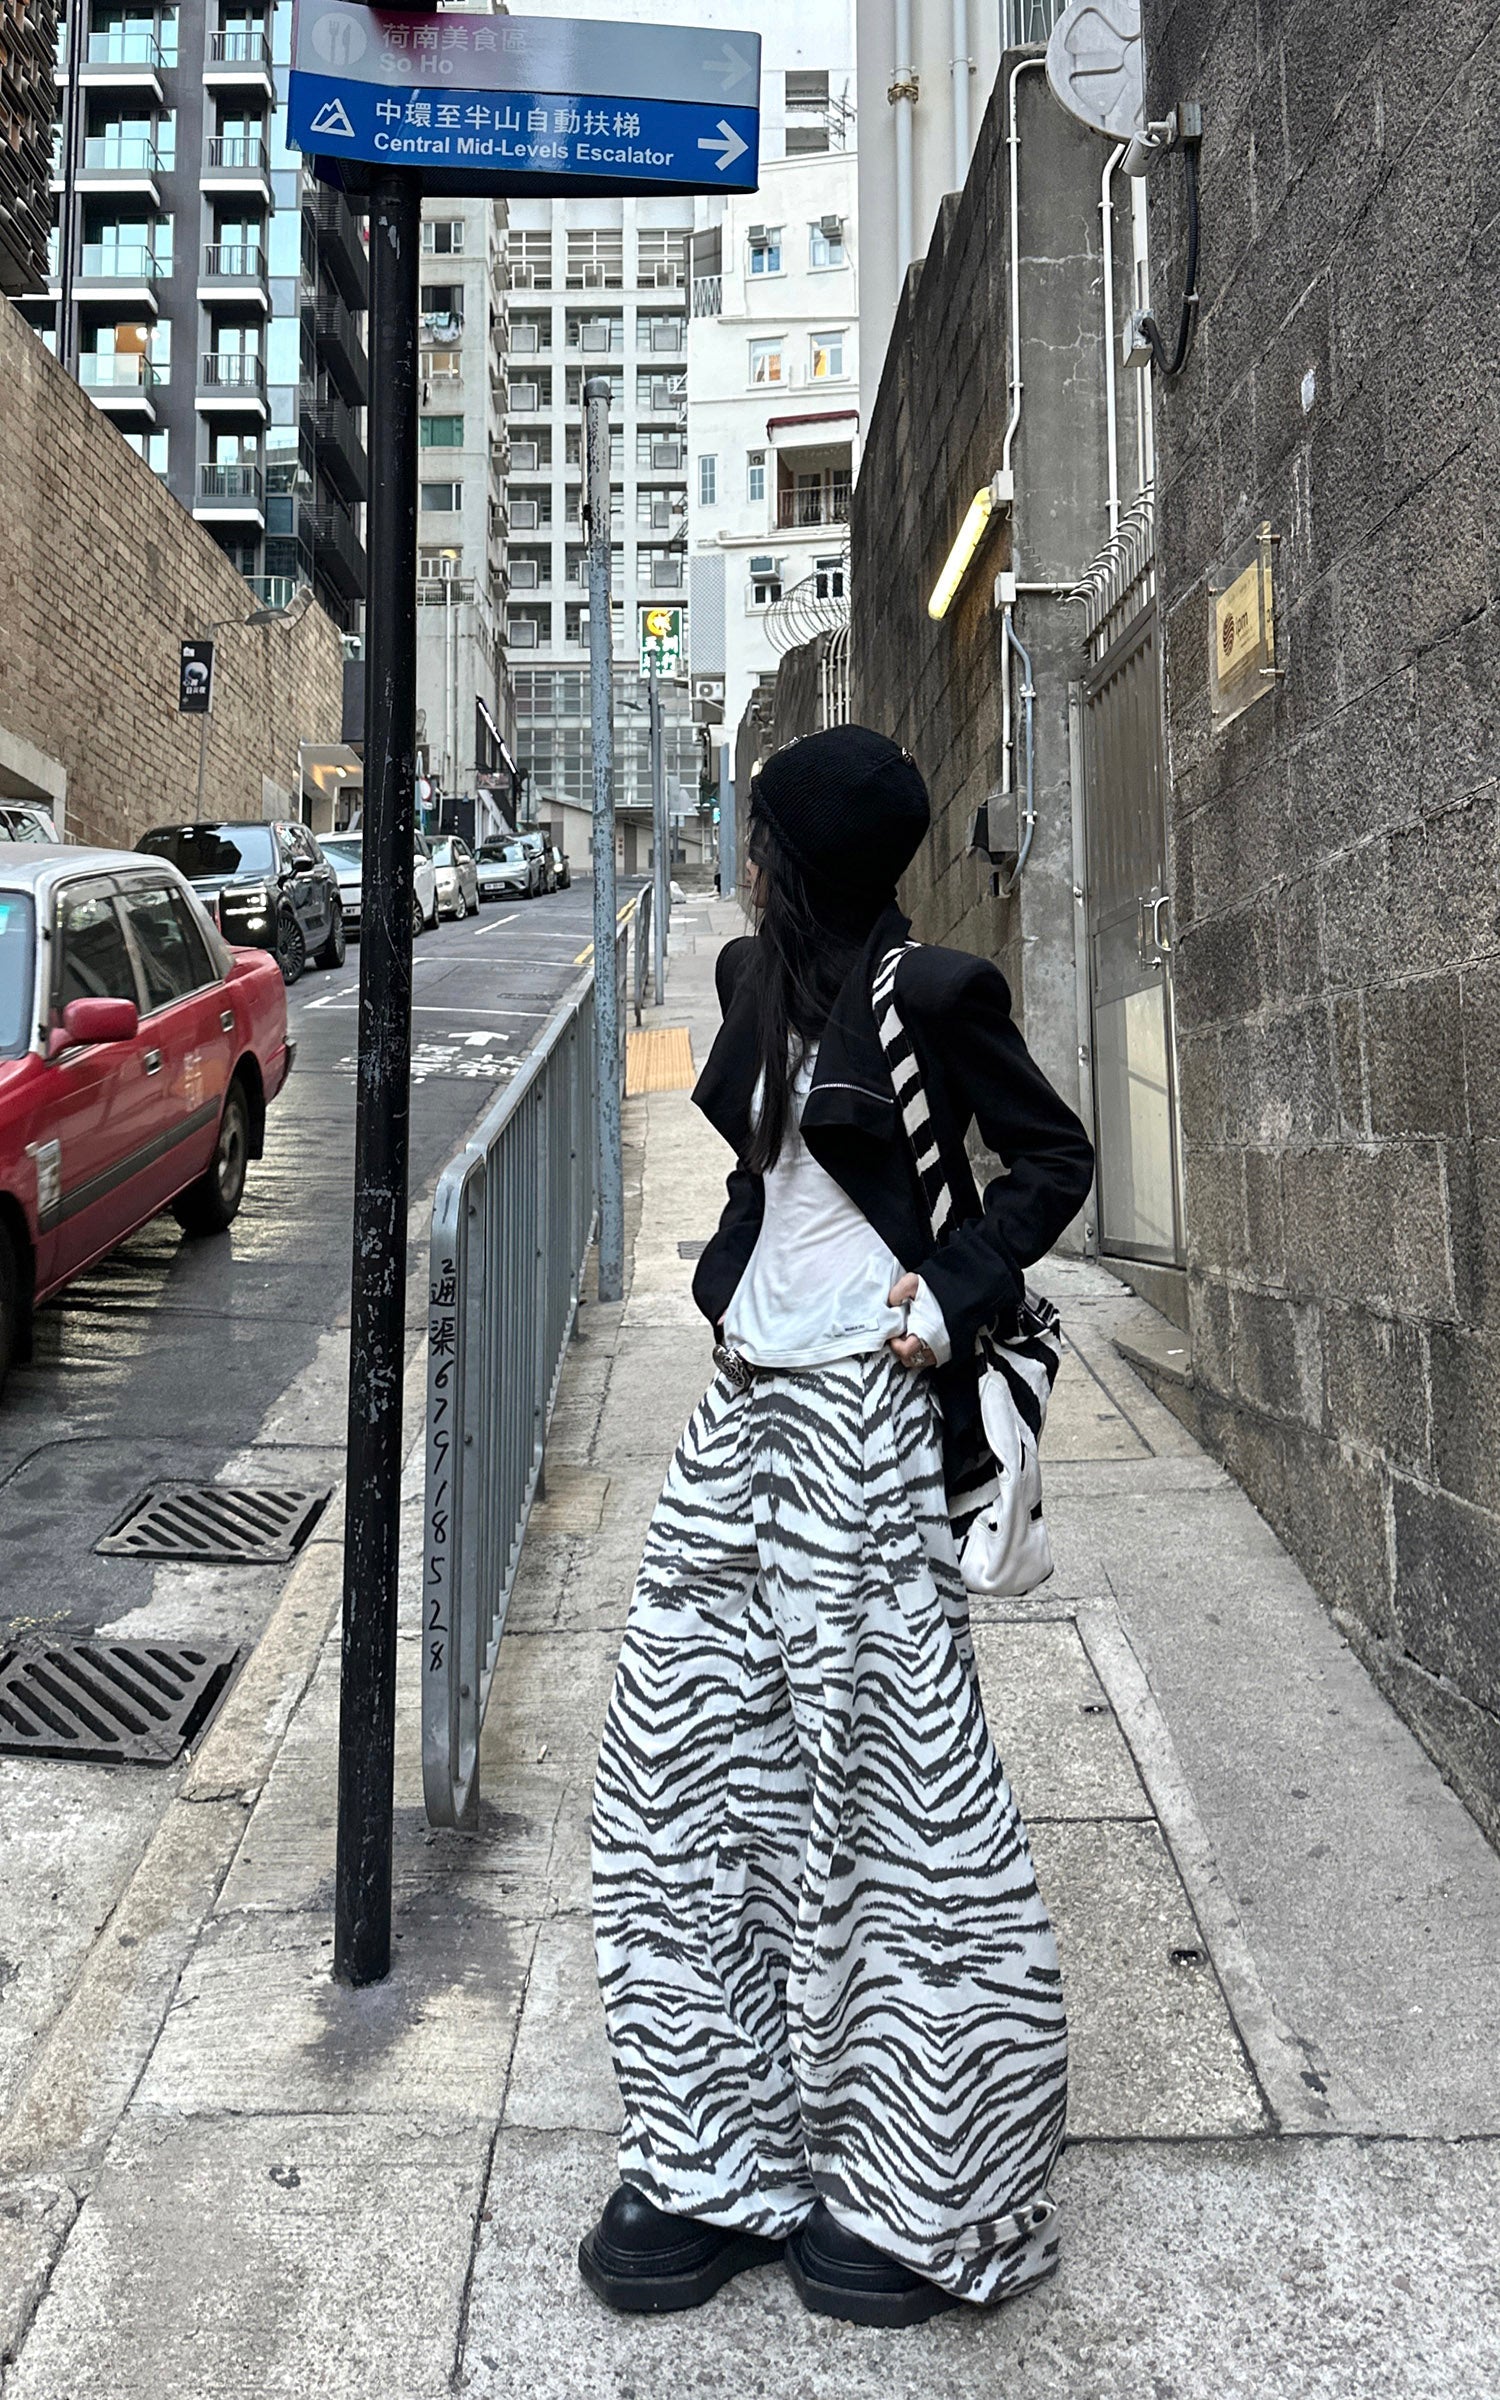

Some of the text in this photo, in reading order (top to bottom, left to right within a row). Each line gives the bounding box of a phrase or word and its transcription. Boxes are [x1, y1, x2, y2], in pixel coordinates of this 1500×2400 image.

[382, 22, 528, 54] 荷南美食區
[379, 54, 454, 75] So Ho
[375, 99, 641, 138] 中環至半山自動扶梯
[374, 132, 675, 166] Central Mid-Levels Escalator
